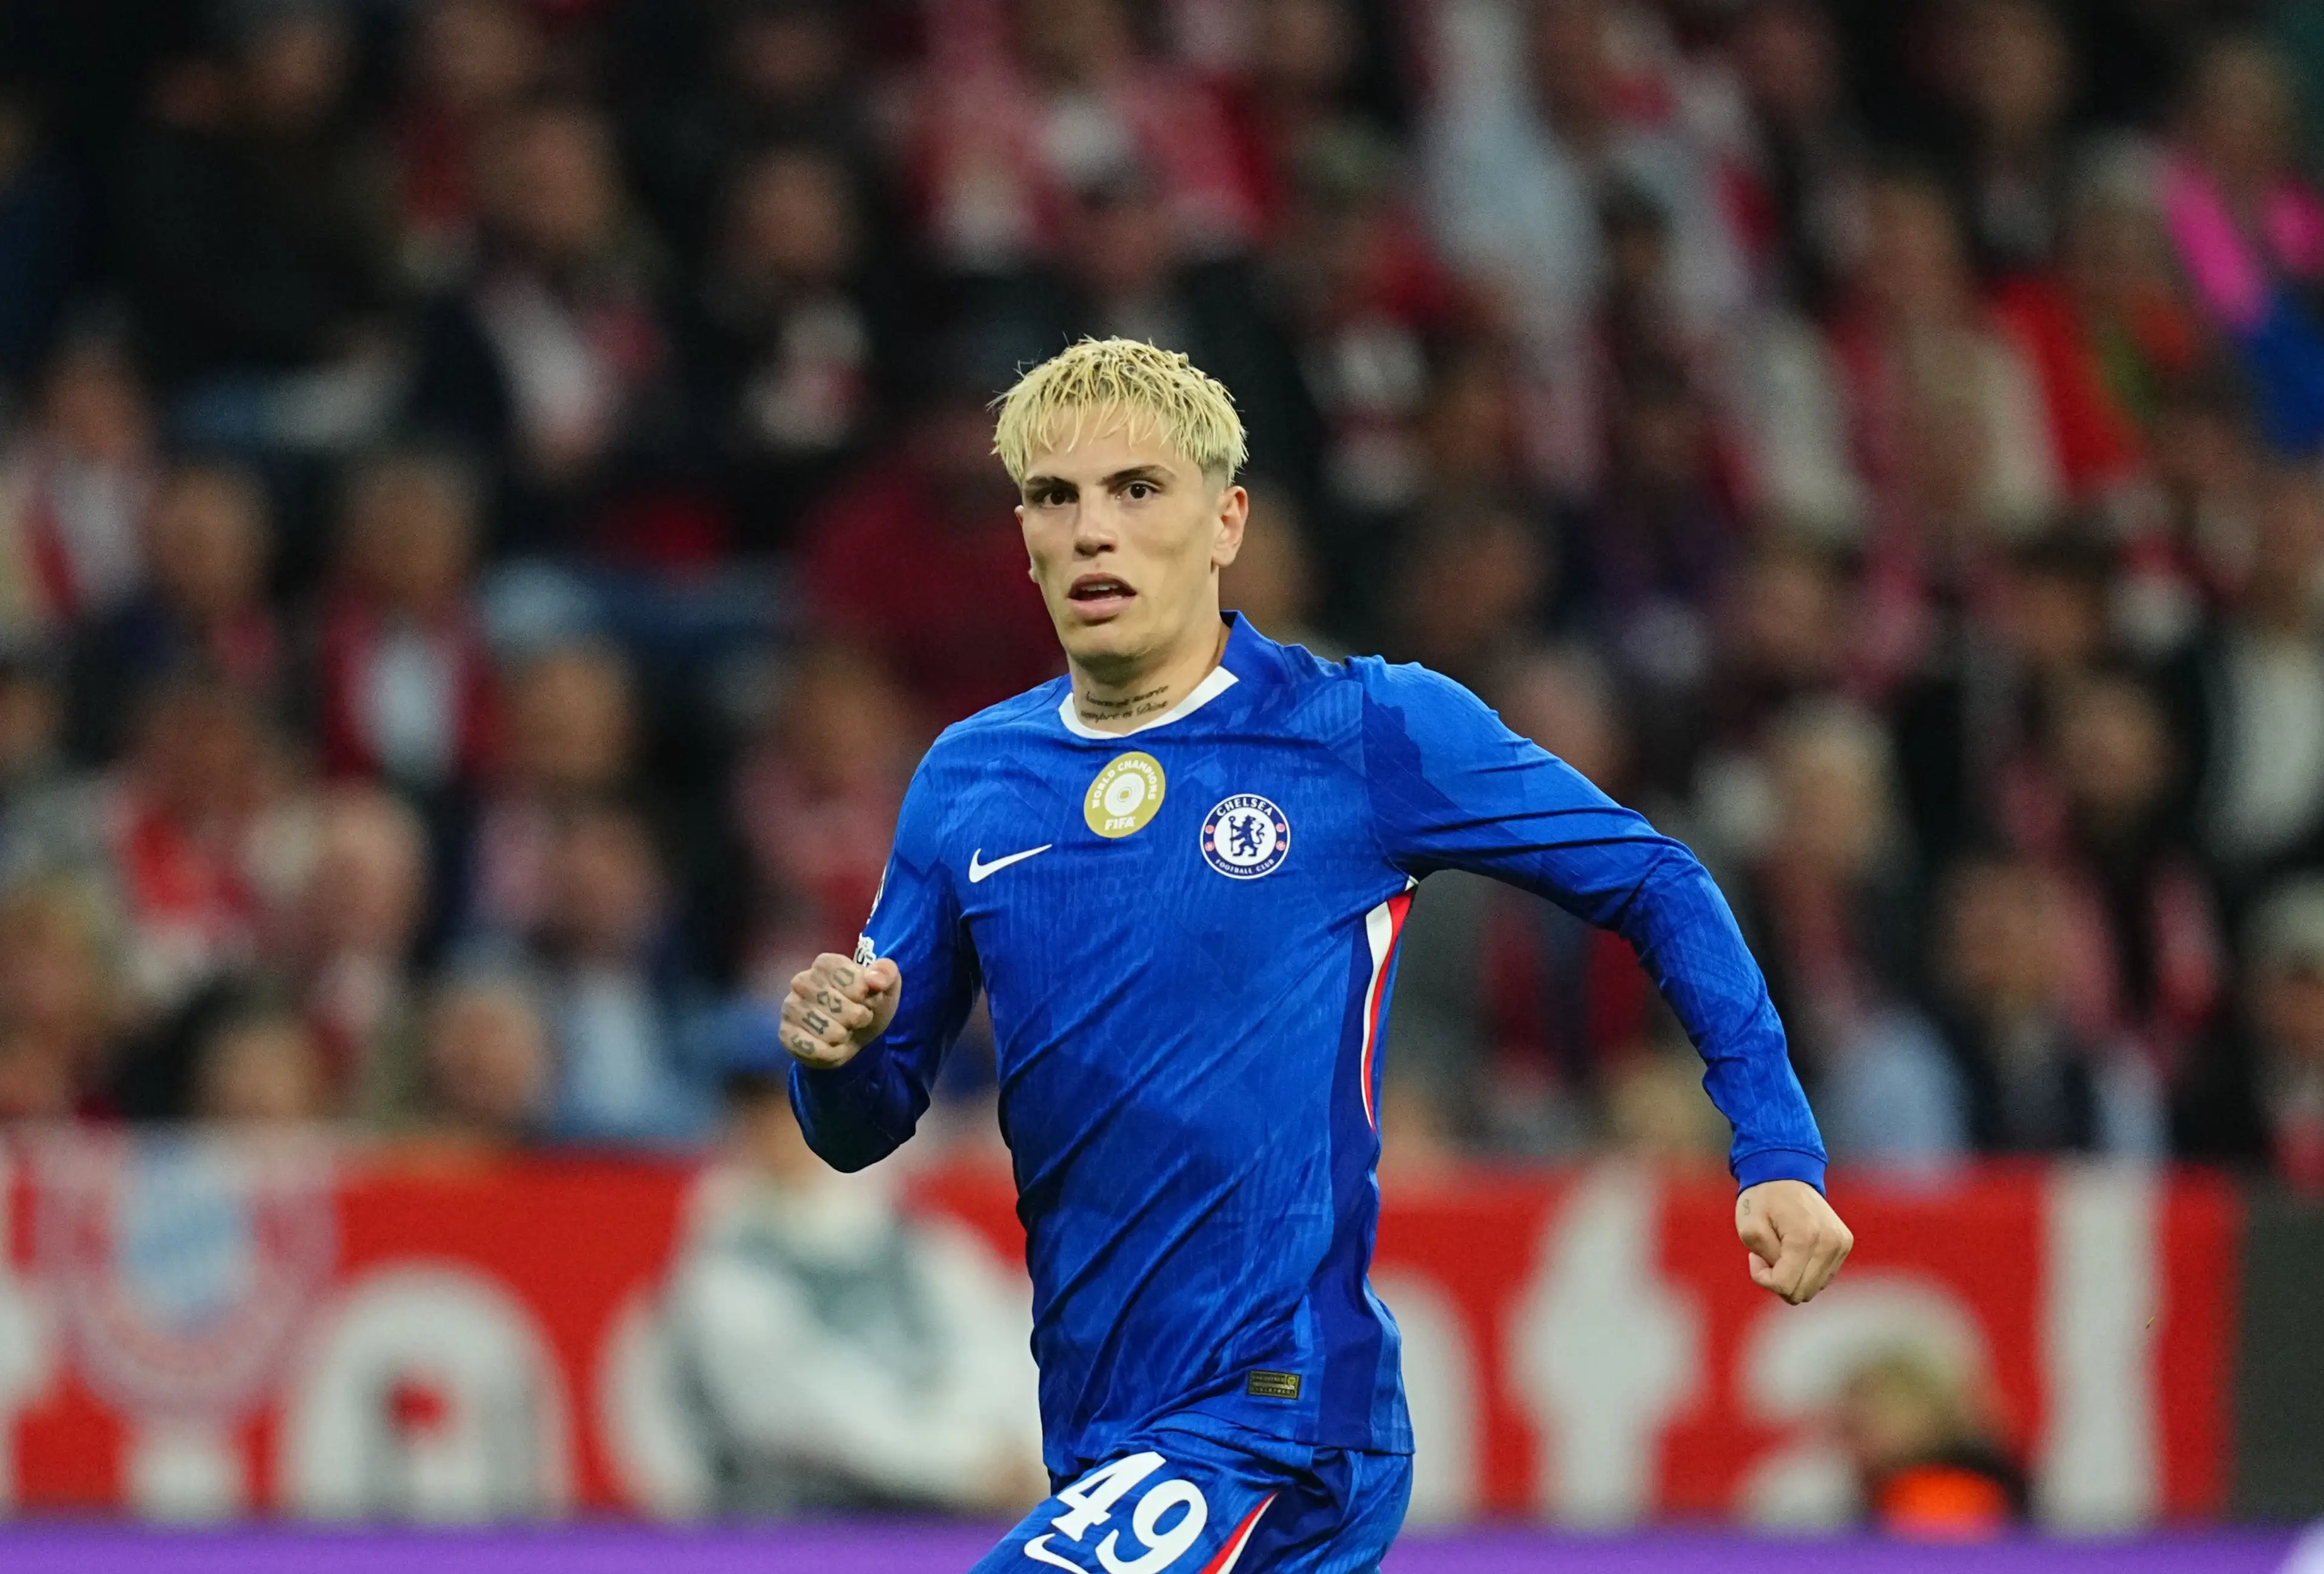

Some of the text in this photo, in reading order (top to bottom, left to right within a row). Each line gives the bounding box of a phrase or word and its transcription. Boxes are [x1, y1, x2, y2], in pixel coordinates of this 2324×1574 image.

[1092, 759, 1158, 809] WORLD CHAMPIONS
[1216, 797, 1273, 817] CHELSEA
[1105, 817, 1136, 831] FIFA
[1215, 858, 1275, 874] FOOTBALL CLUB
[1051, 1451, 1208, 1574] 49
